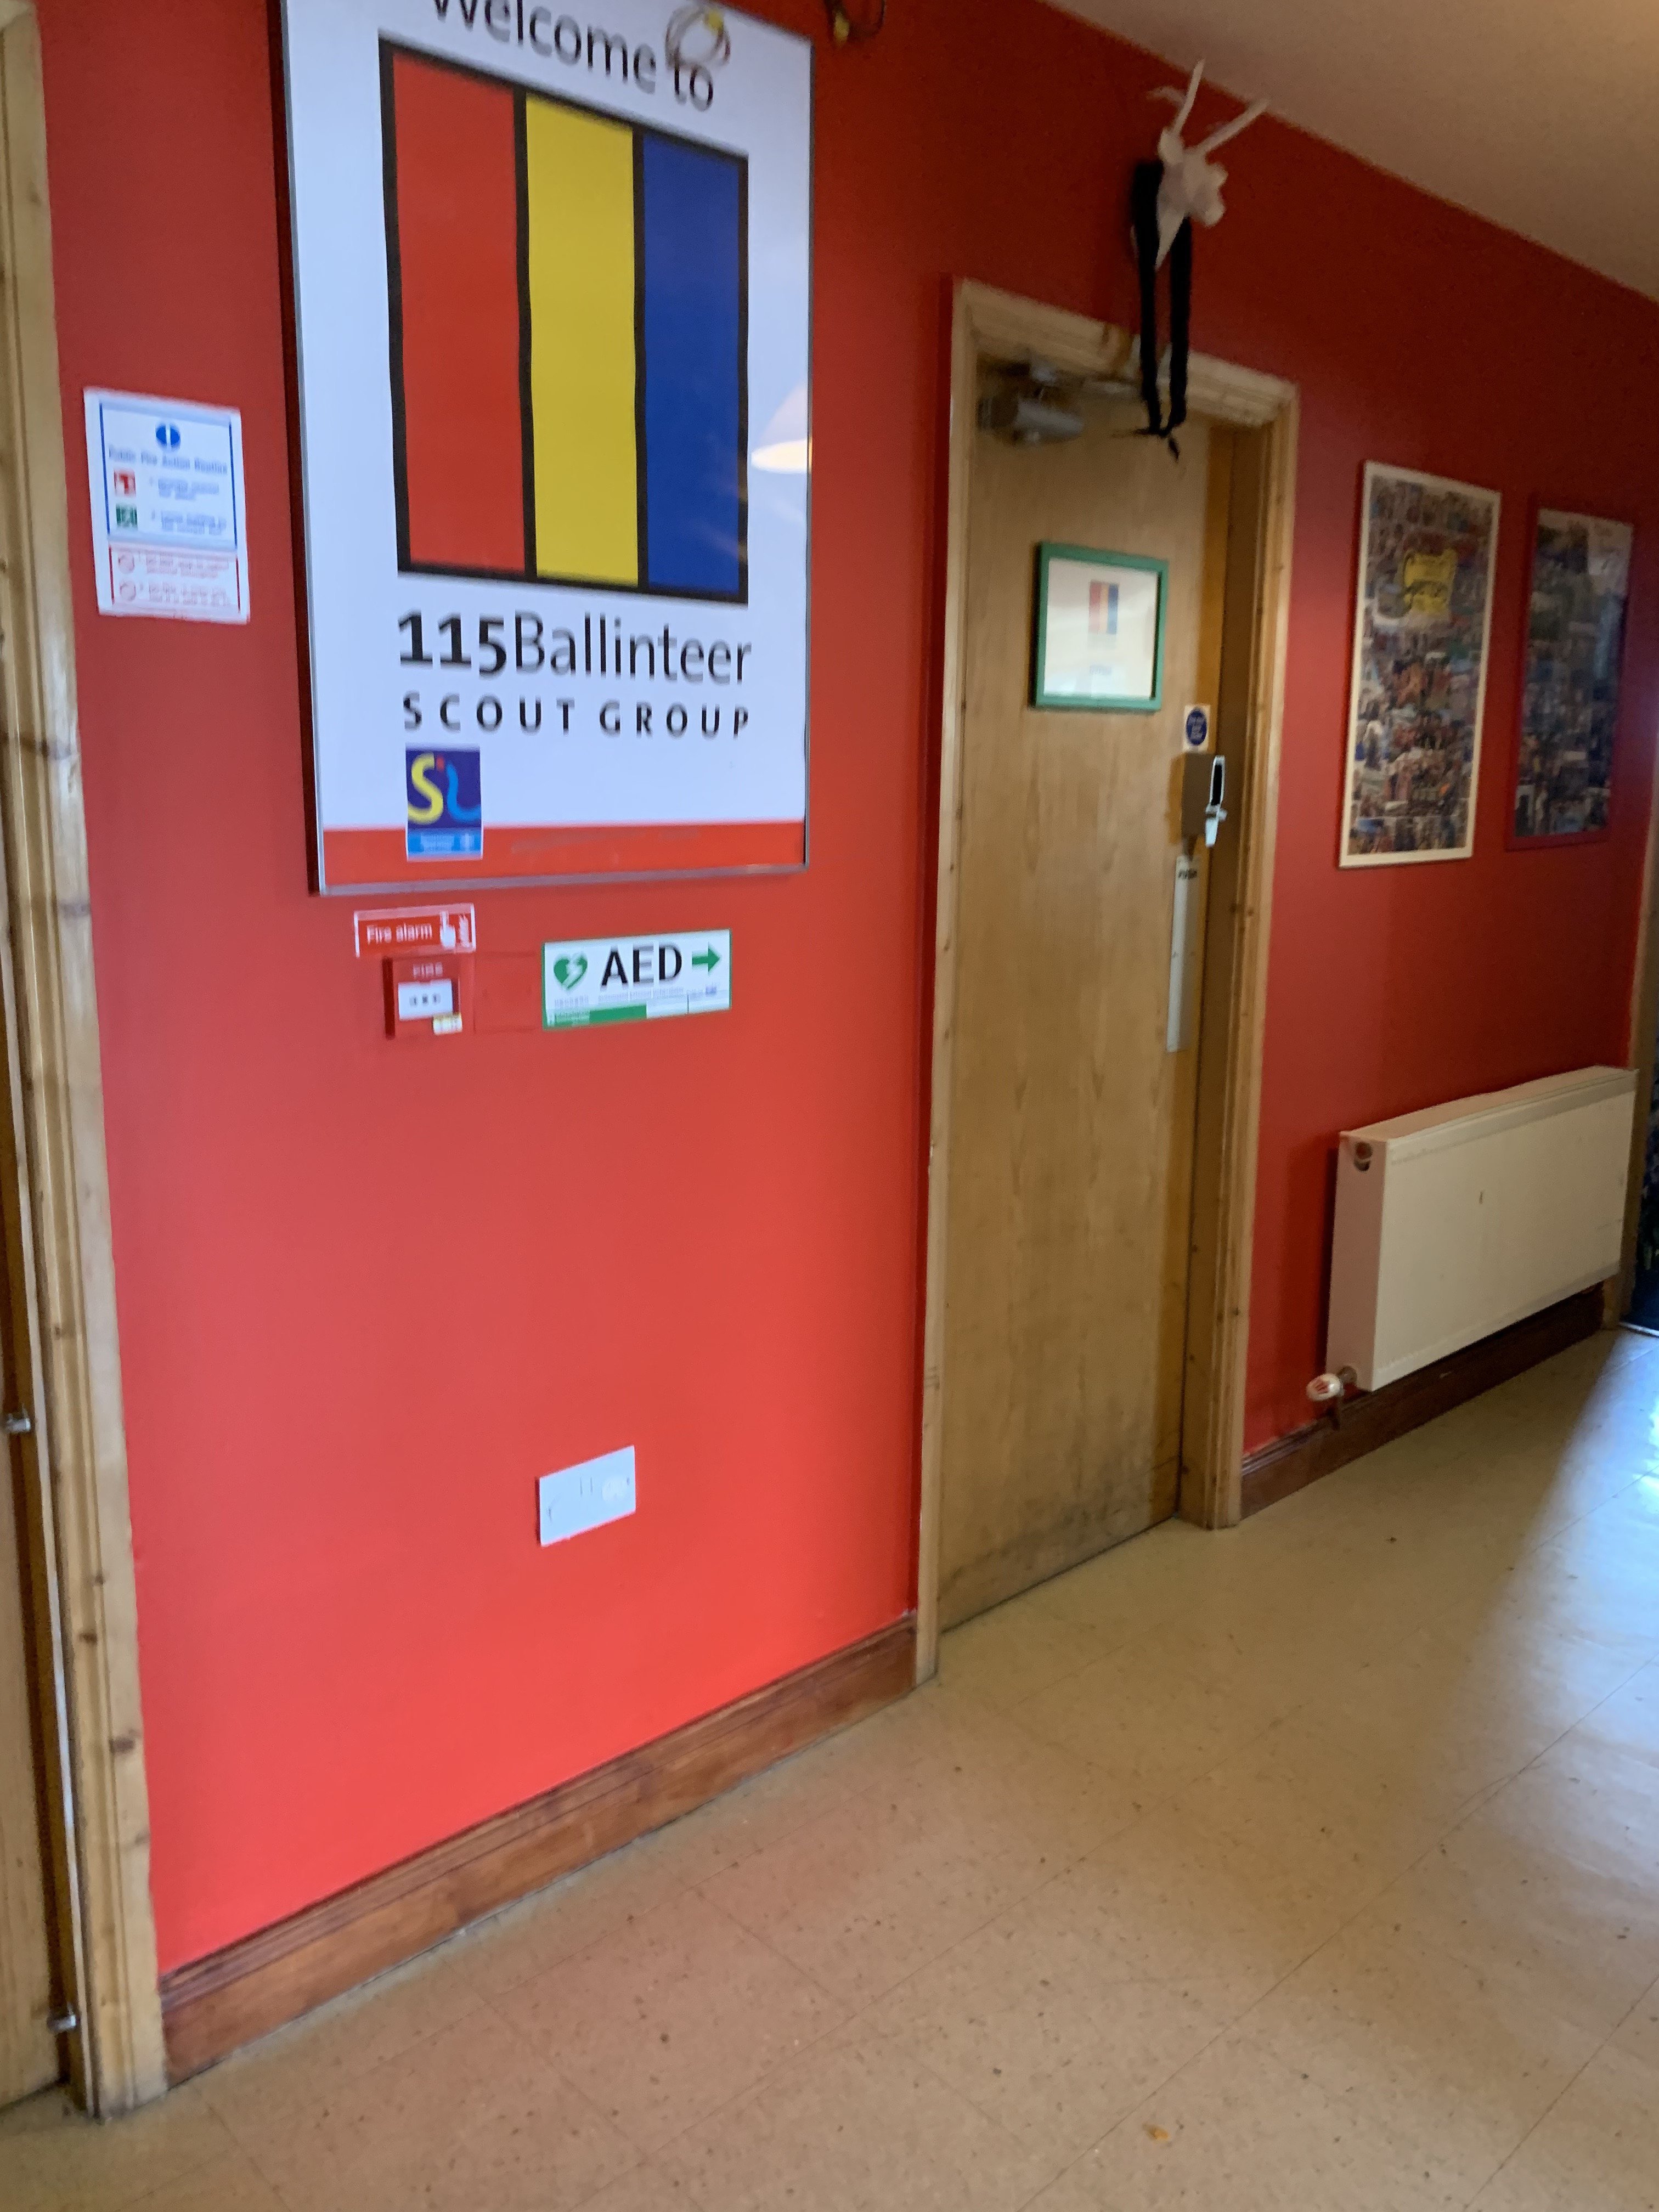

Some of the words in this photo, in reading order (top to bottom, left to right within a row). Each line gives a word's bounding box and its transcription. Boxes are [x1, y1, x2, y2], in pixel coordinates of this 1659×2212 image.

[433, 0, 657, 94] Welcome
[673, 44, 713, 111] to
[403, 690, 575, 736] SCOUT
[599, 698, 749, 740] GROUP
[367, 924, 392, 945] Fire
[396, 923, 432, 943] alarm
[600, 943, 683, 991] AED
